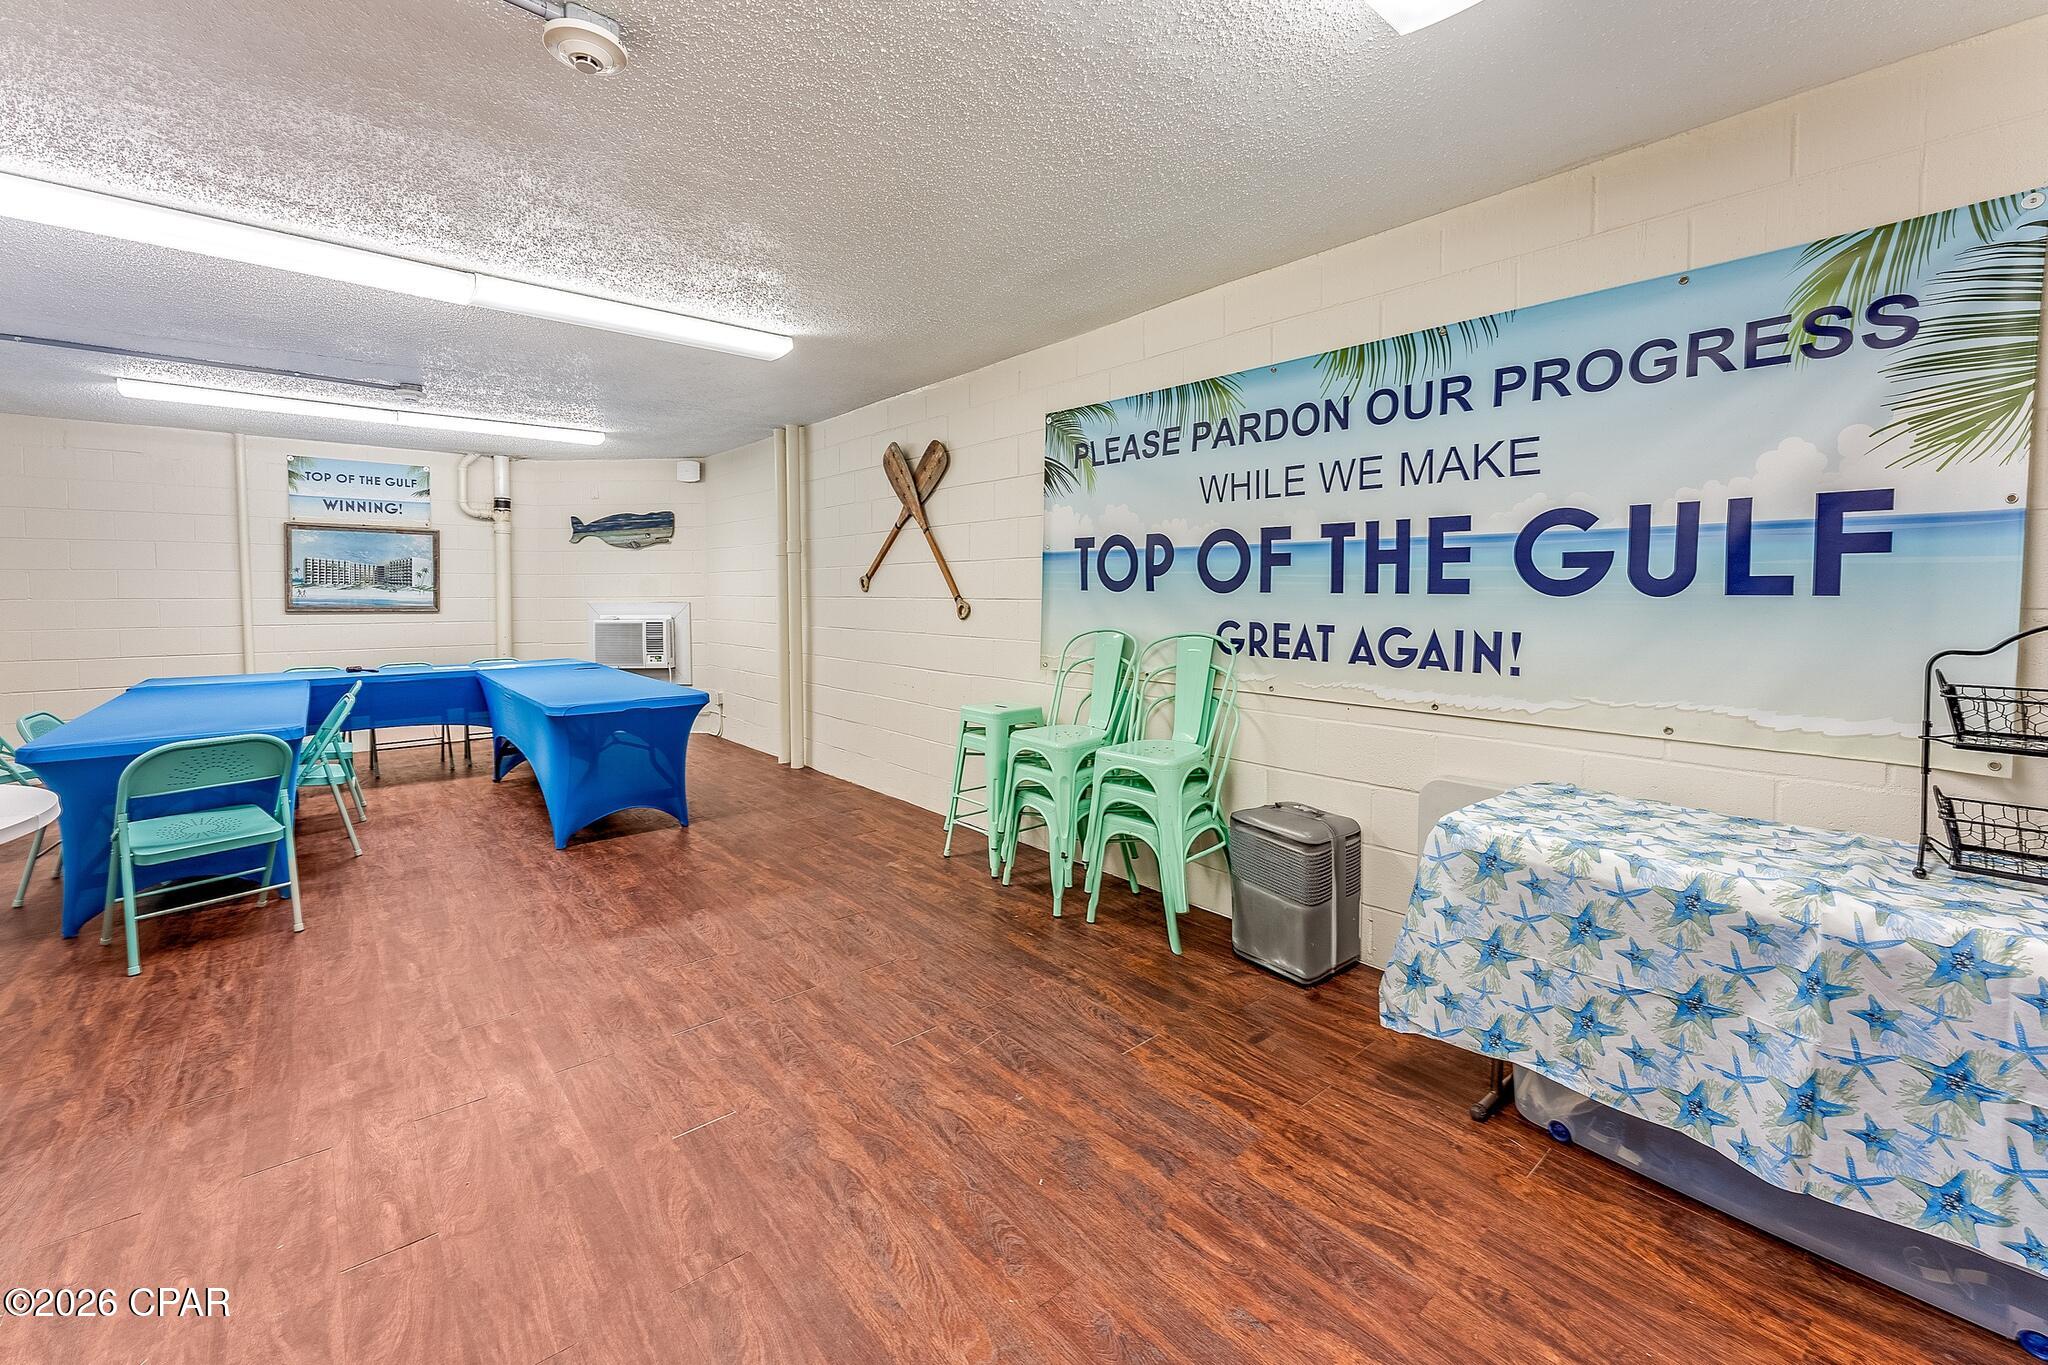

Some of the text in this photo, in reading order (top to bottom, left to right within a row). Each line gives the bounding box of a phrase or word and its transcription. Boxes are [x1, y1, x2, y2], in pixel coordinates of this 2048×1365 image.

[1074, 294, 1920, 468] PLEASE PARDON OUR PROGRESS
[305, 471, 417, 488] TOP OF THE GULF
[1200, 436, 1541, 504] WHILE WE MAKE
[323, 499, 402, 514] WINNING!
[1074, 488, 1895, 597] TOP OF THE GULF
[1216, 620, 1522, 676] GREAT AGAIN!
